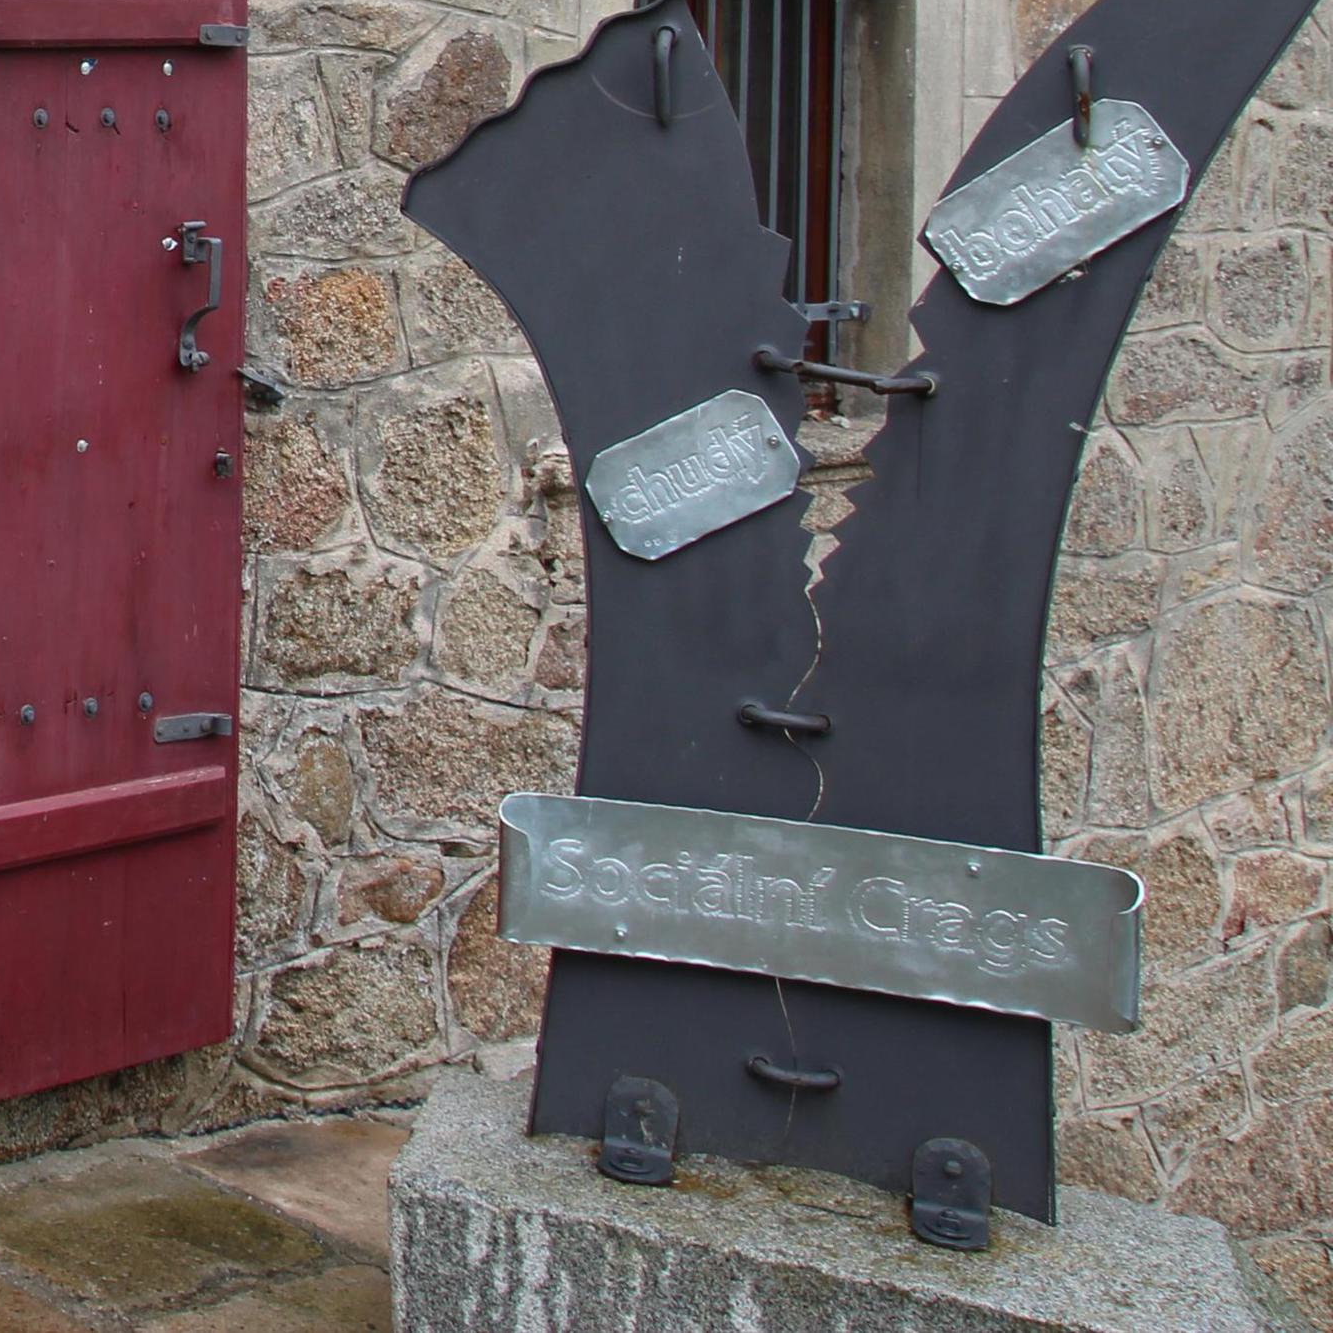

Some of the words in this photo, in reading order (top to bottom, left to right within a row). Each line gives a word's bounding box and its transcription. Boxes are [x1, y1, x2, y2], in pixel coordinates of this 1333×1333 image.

[937, 119, 1165, 282] bohatý
[609, 412, 771, 524] chudý
[538, 837, 837, 932] Sociální
